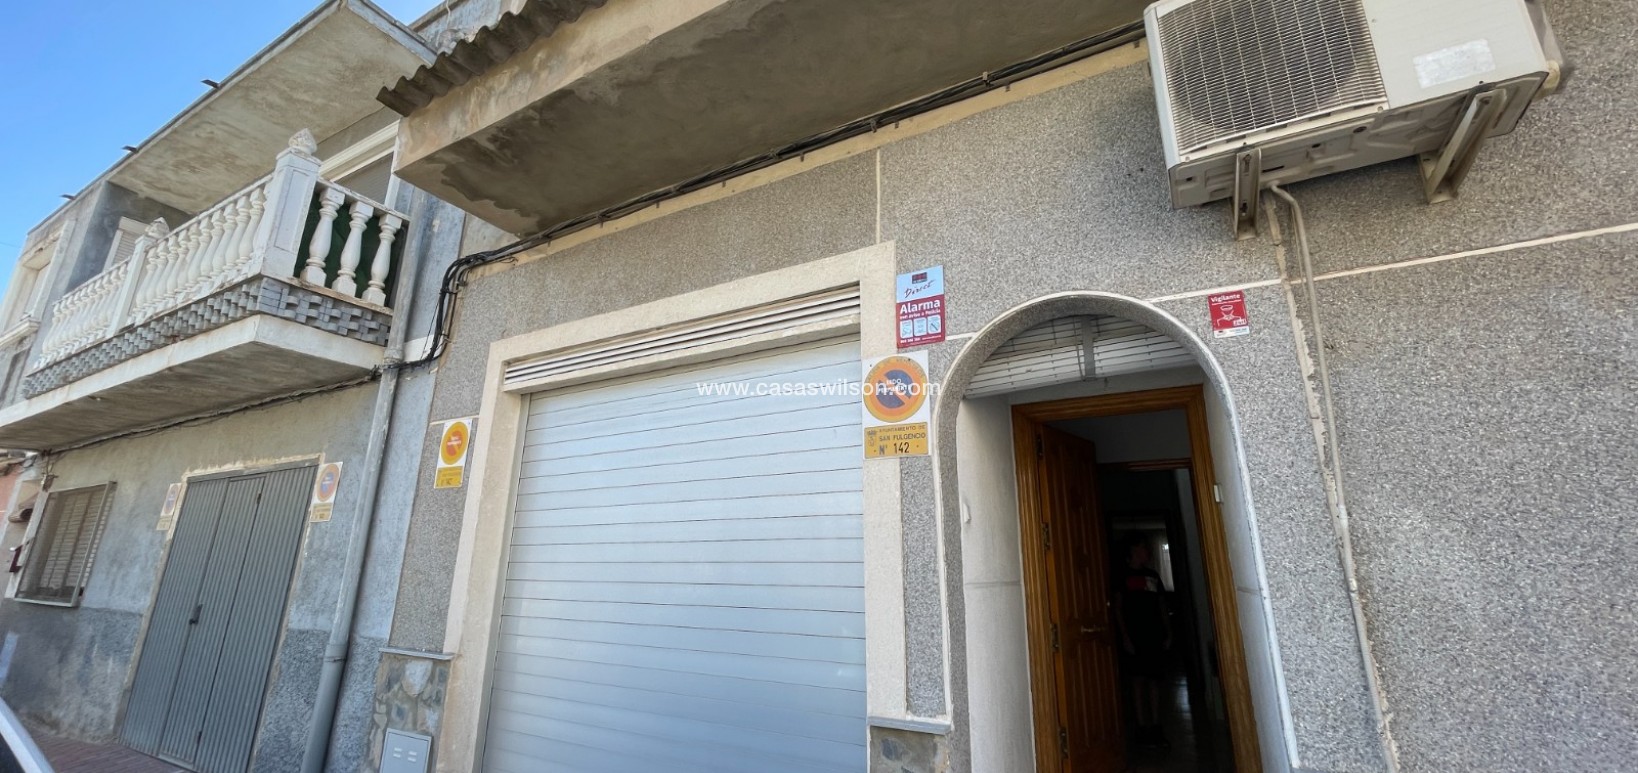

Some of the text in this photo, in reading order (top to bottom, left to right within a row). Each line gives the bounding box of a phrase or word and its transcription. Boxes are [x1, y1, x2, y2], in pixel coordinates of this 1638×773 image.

[1210, 294, 1241, 302] Vigilante
[900, 299, 941, 314] Alarma
[893, 432, 926, 441] FULGENCIO
[893, 441, 910, 454] 142
